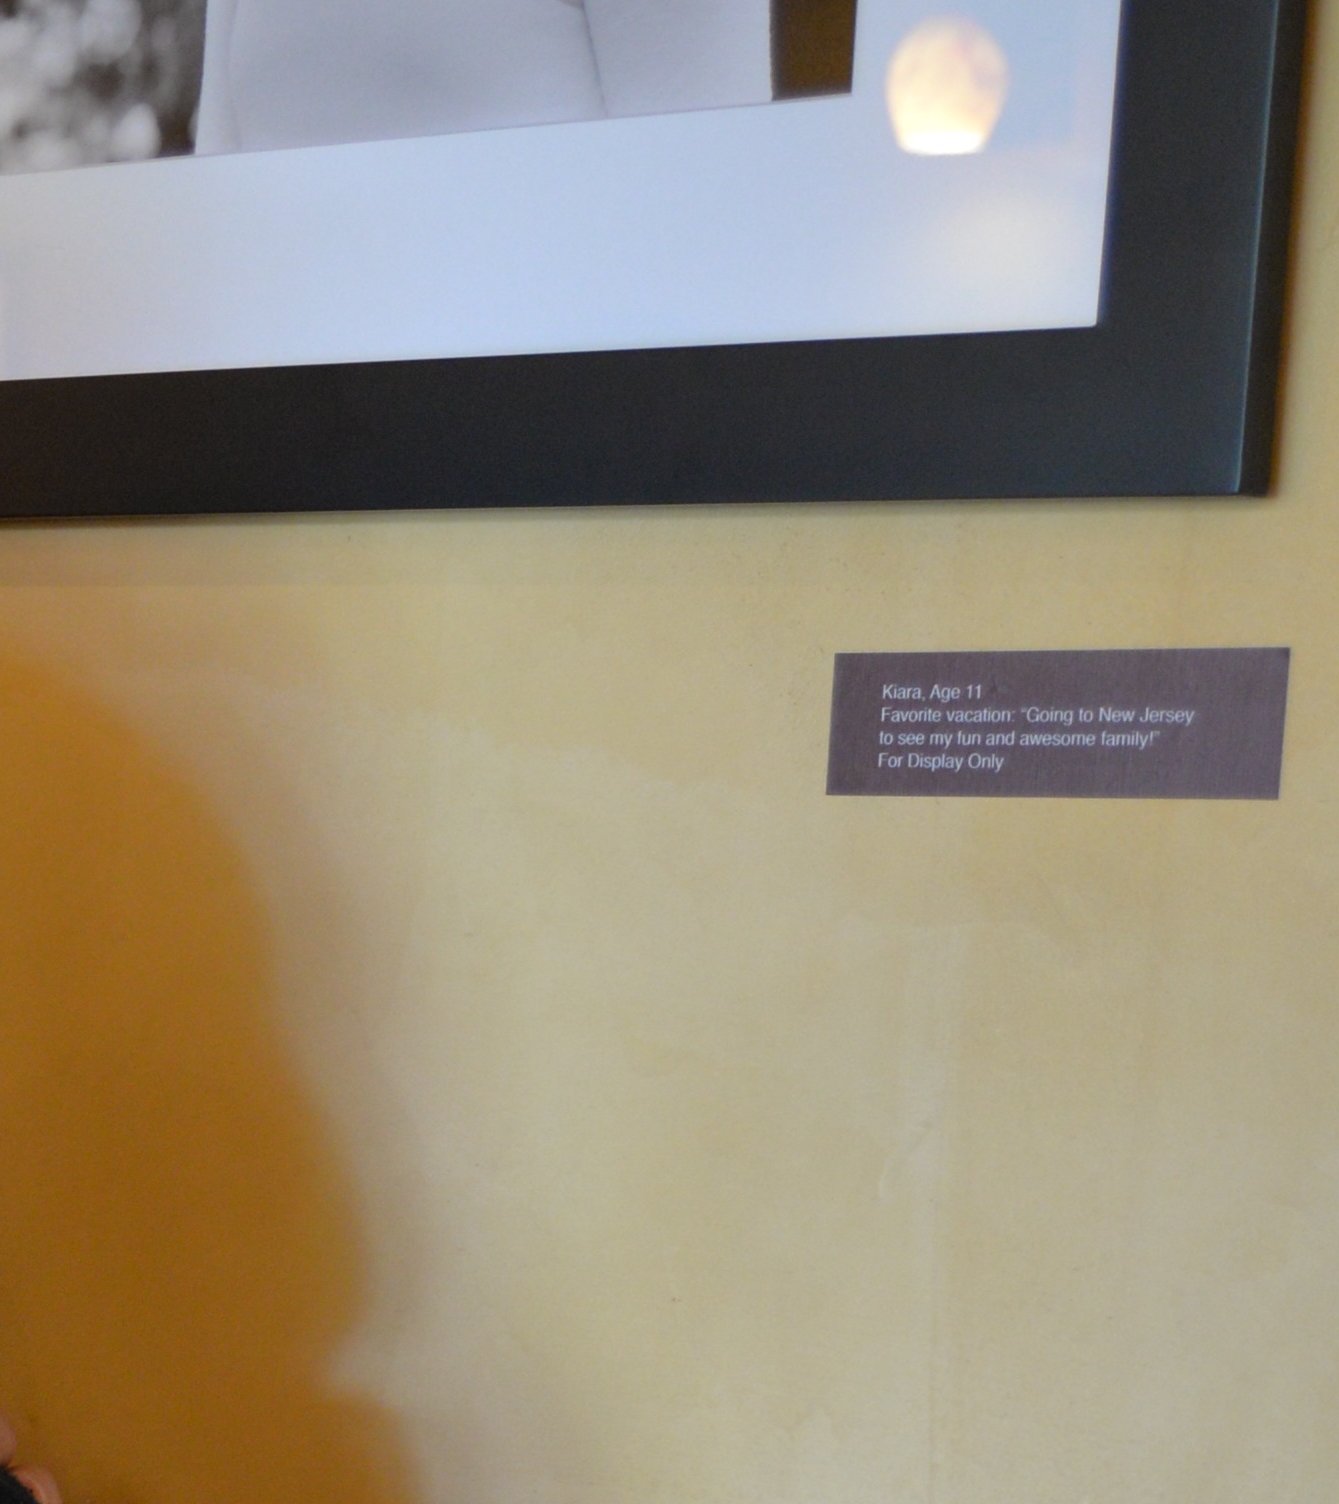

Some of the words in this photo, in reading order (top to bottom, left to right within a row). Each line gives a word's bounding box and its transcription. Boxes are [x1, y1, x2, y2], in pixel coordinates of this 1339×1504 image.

[881, 684, 926, 702] Kiara,
[929, 684, 961, 703] Age
[965, 684, 982, 699] 11
[880, 706, 942, 723] Favorite
[946, 706, 1016, 723] vacation:
[1078, 707, 1094, 723] to
[1098, 706, 1135, 723] New
[1139, 707, 1195, 726] Jersey
[879, 730, 893, 745] to
[897, 733, 925, 745] see
[929, 733, 953, 749] my
[957, 730, 981, 745] fun
[985, 730, 1016, 746] and
[1019, 733, 1096, 746] awesome
[877, 752, 903, 768] For
[907, 752, 964, 773] Display
[968, 752, 1004, 773] Only
